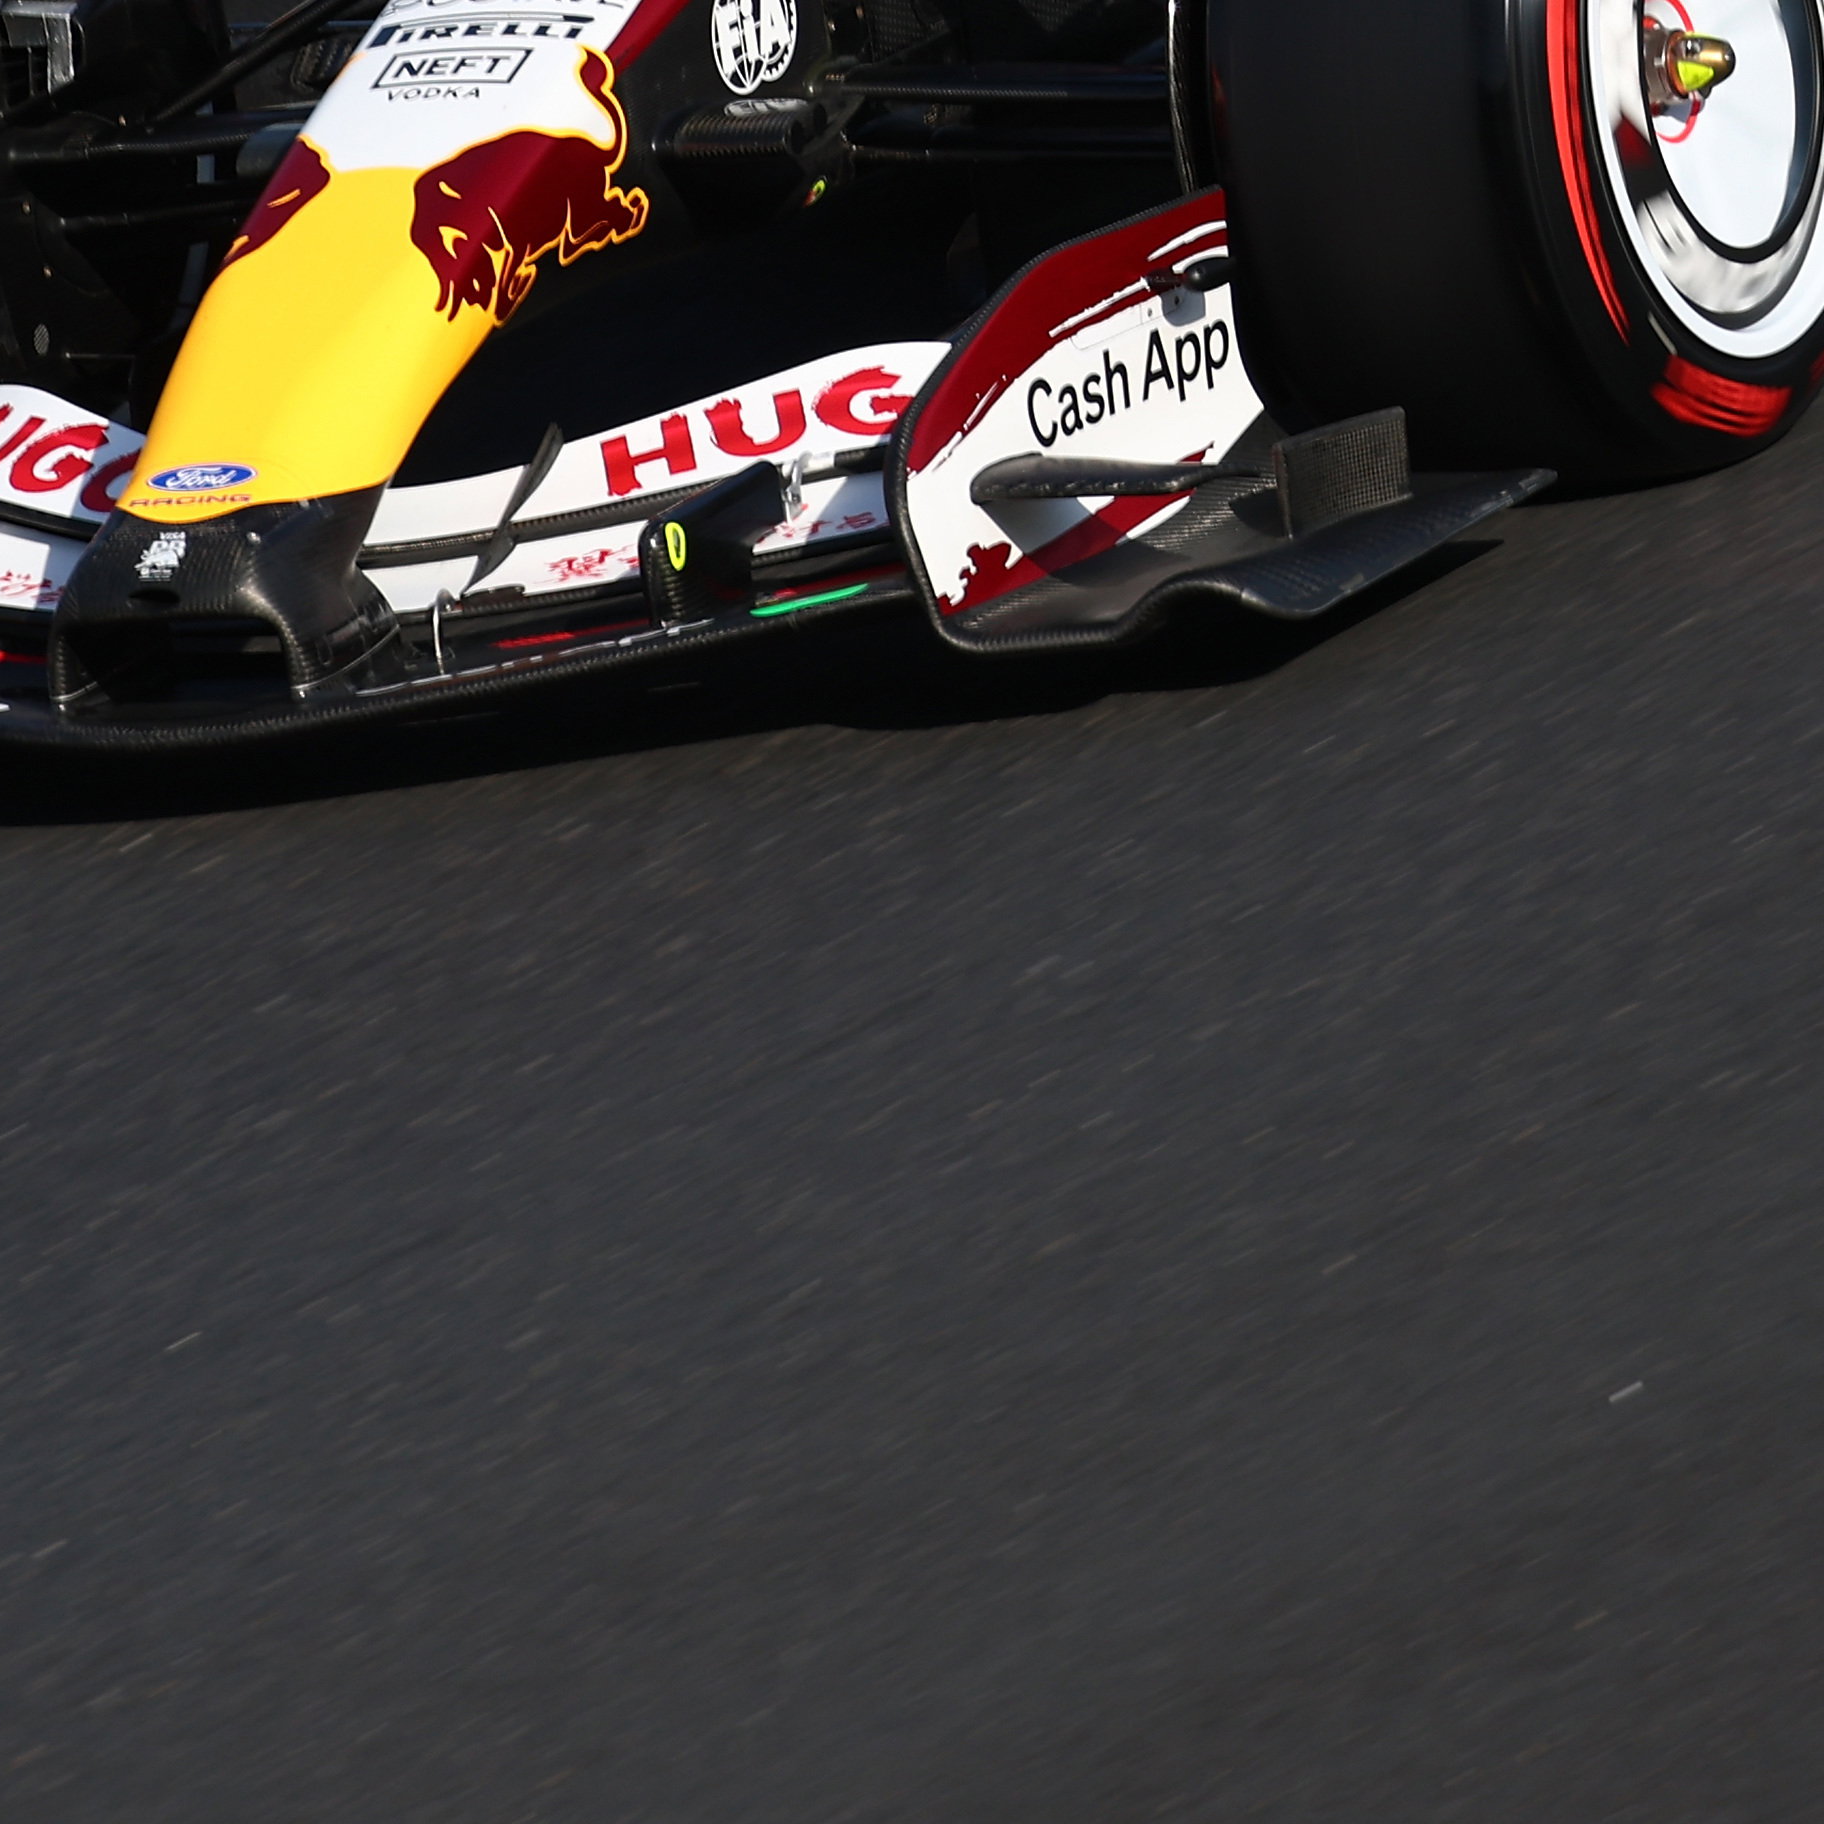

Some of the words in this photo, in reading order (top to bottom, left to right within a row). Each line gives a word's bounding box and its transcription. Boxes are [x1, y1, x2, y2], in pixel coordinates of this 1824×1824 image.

[366, 10, 595, 49] PIRELLI
[392, 54, 512, 78] NEFT
[387, 87, 481, 102] VODKA
[1026, 351, 1135, 449] Cash
[1139, 312, 1231, 400] App
[599, 368, 918, 498] HUG
[165, 466, 238, 489] Ford
[128, 494, 252, 508] RACING
